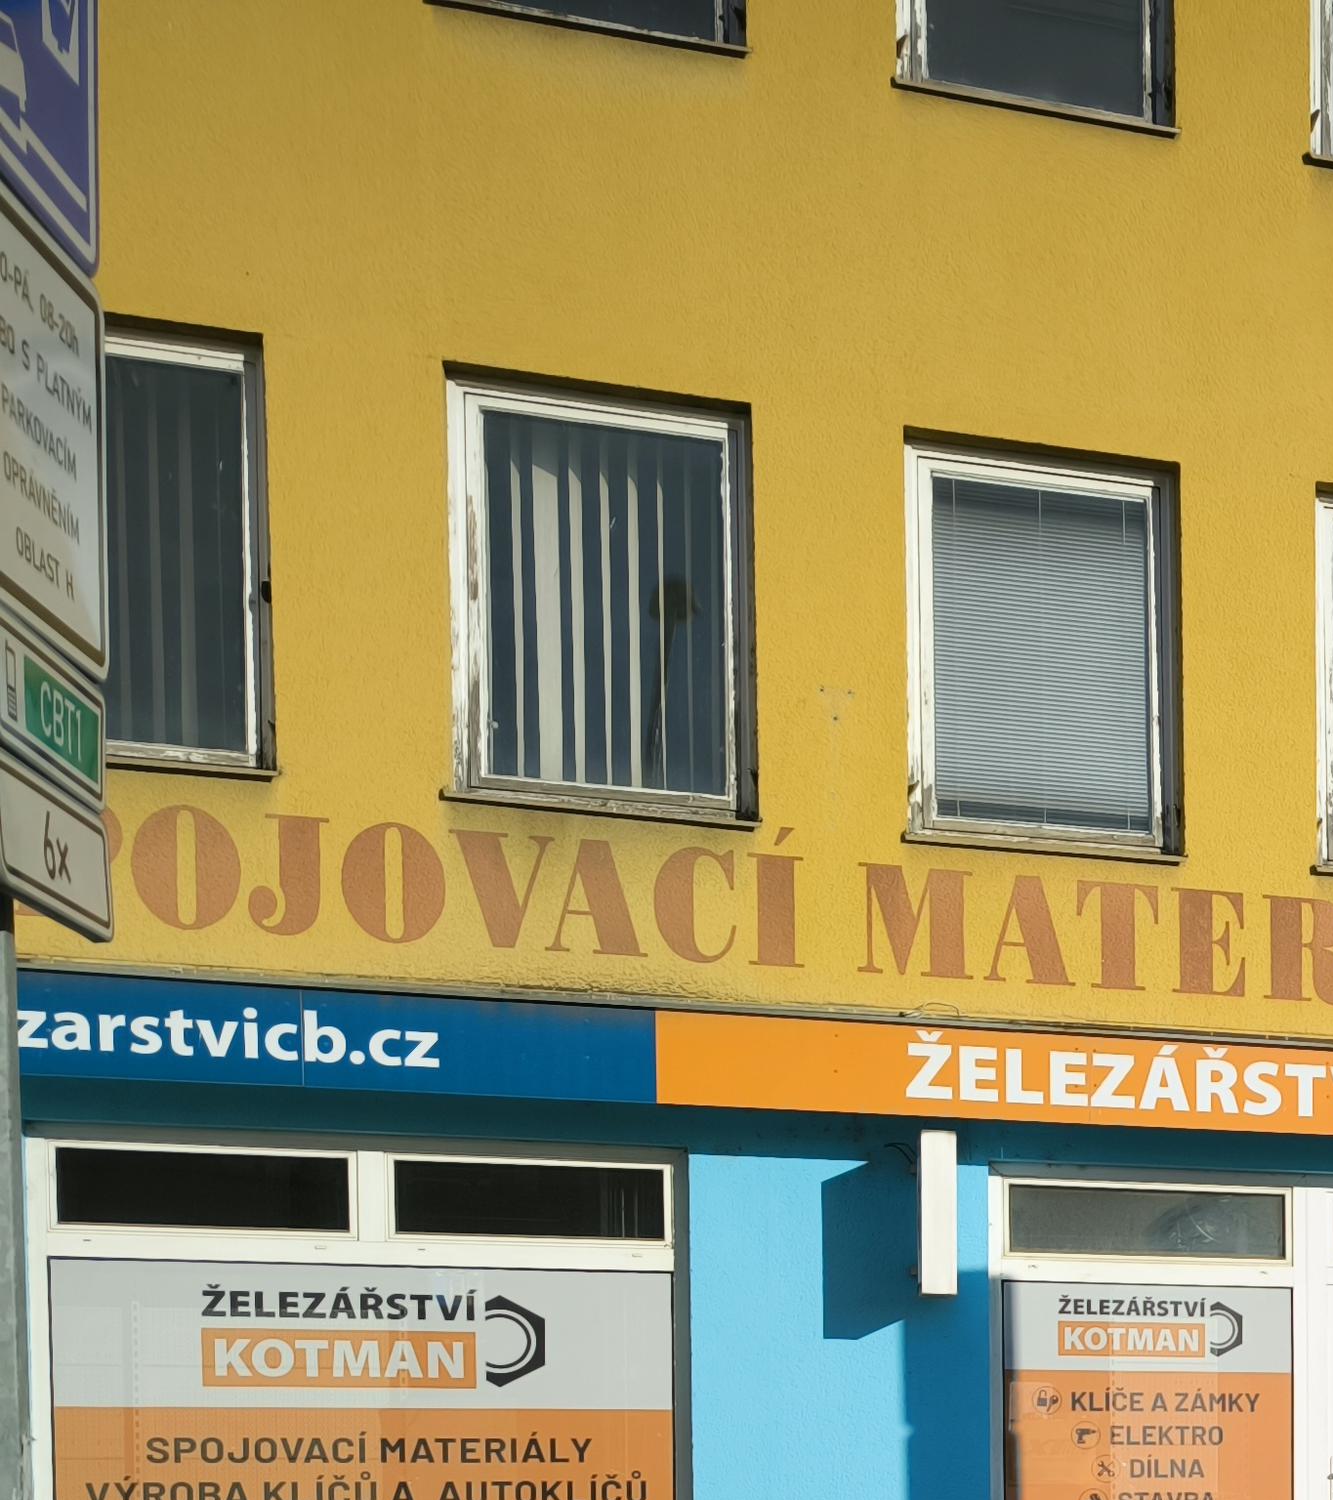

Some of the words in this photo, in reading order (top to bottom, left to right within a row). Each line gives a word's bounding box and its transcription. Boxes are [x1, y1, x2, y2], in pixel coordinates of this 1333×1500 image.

[21, 338, 30, 371] S
[36, 352, 92, 434] PLATNÝM
[1, 383, 77, 481] PARKOVACÍM
[4, 450, 80, 545] OPRÁVNĚNÍM
[16, 526, 60, 589] OBLAST
[66, 568, 75, 600] H
[40, 681, 82, 761] CBT1
[43, 810, 71, 884] 6x
[17, 1007, 441, 1069] zarstvicb.cz
[201, 1283, 477, 1321] ŽELEZÁŘSTVÍ
[1058, 1294, 1206, 1317] ŽELEZÁŘSTVÍ
[214, 1337, 465, 1379] KOTMAN
[1064, 1326, 1199, 1352] KOTMAN
[1071, 1387, 1144, 1412] KLÍČE
[1151, 1392, 1168, 1412] A
[1175, 1387, 1261, 1413] ZÁMKY
[145, 1431, 367, 1464] SPOJOVACÍ
[380, 1431, 593, 1464] MATERIÁLY
[1110, 1425, 1223, 1445] ELEKTRO
[1129, 1454, 1205, 1478] DÍLNA
